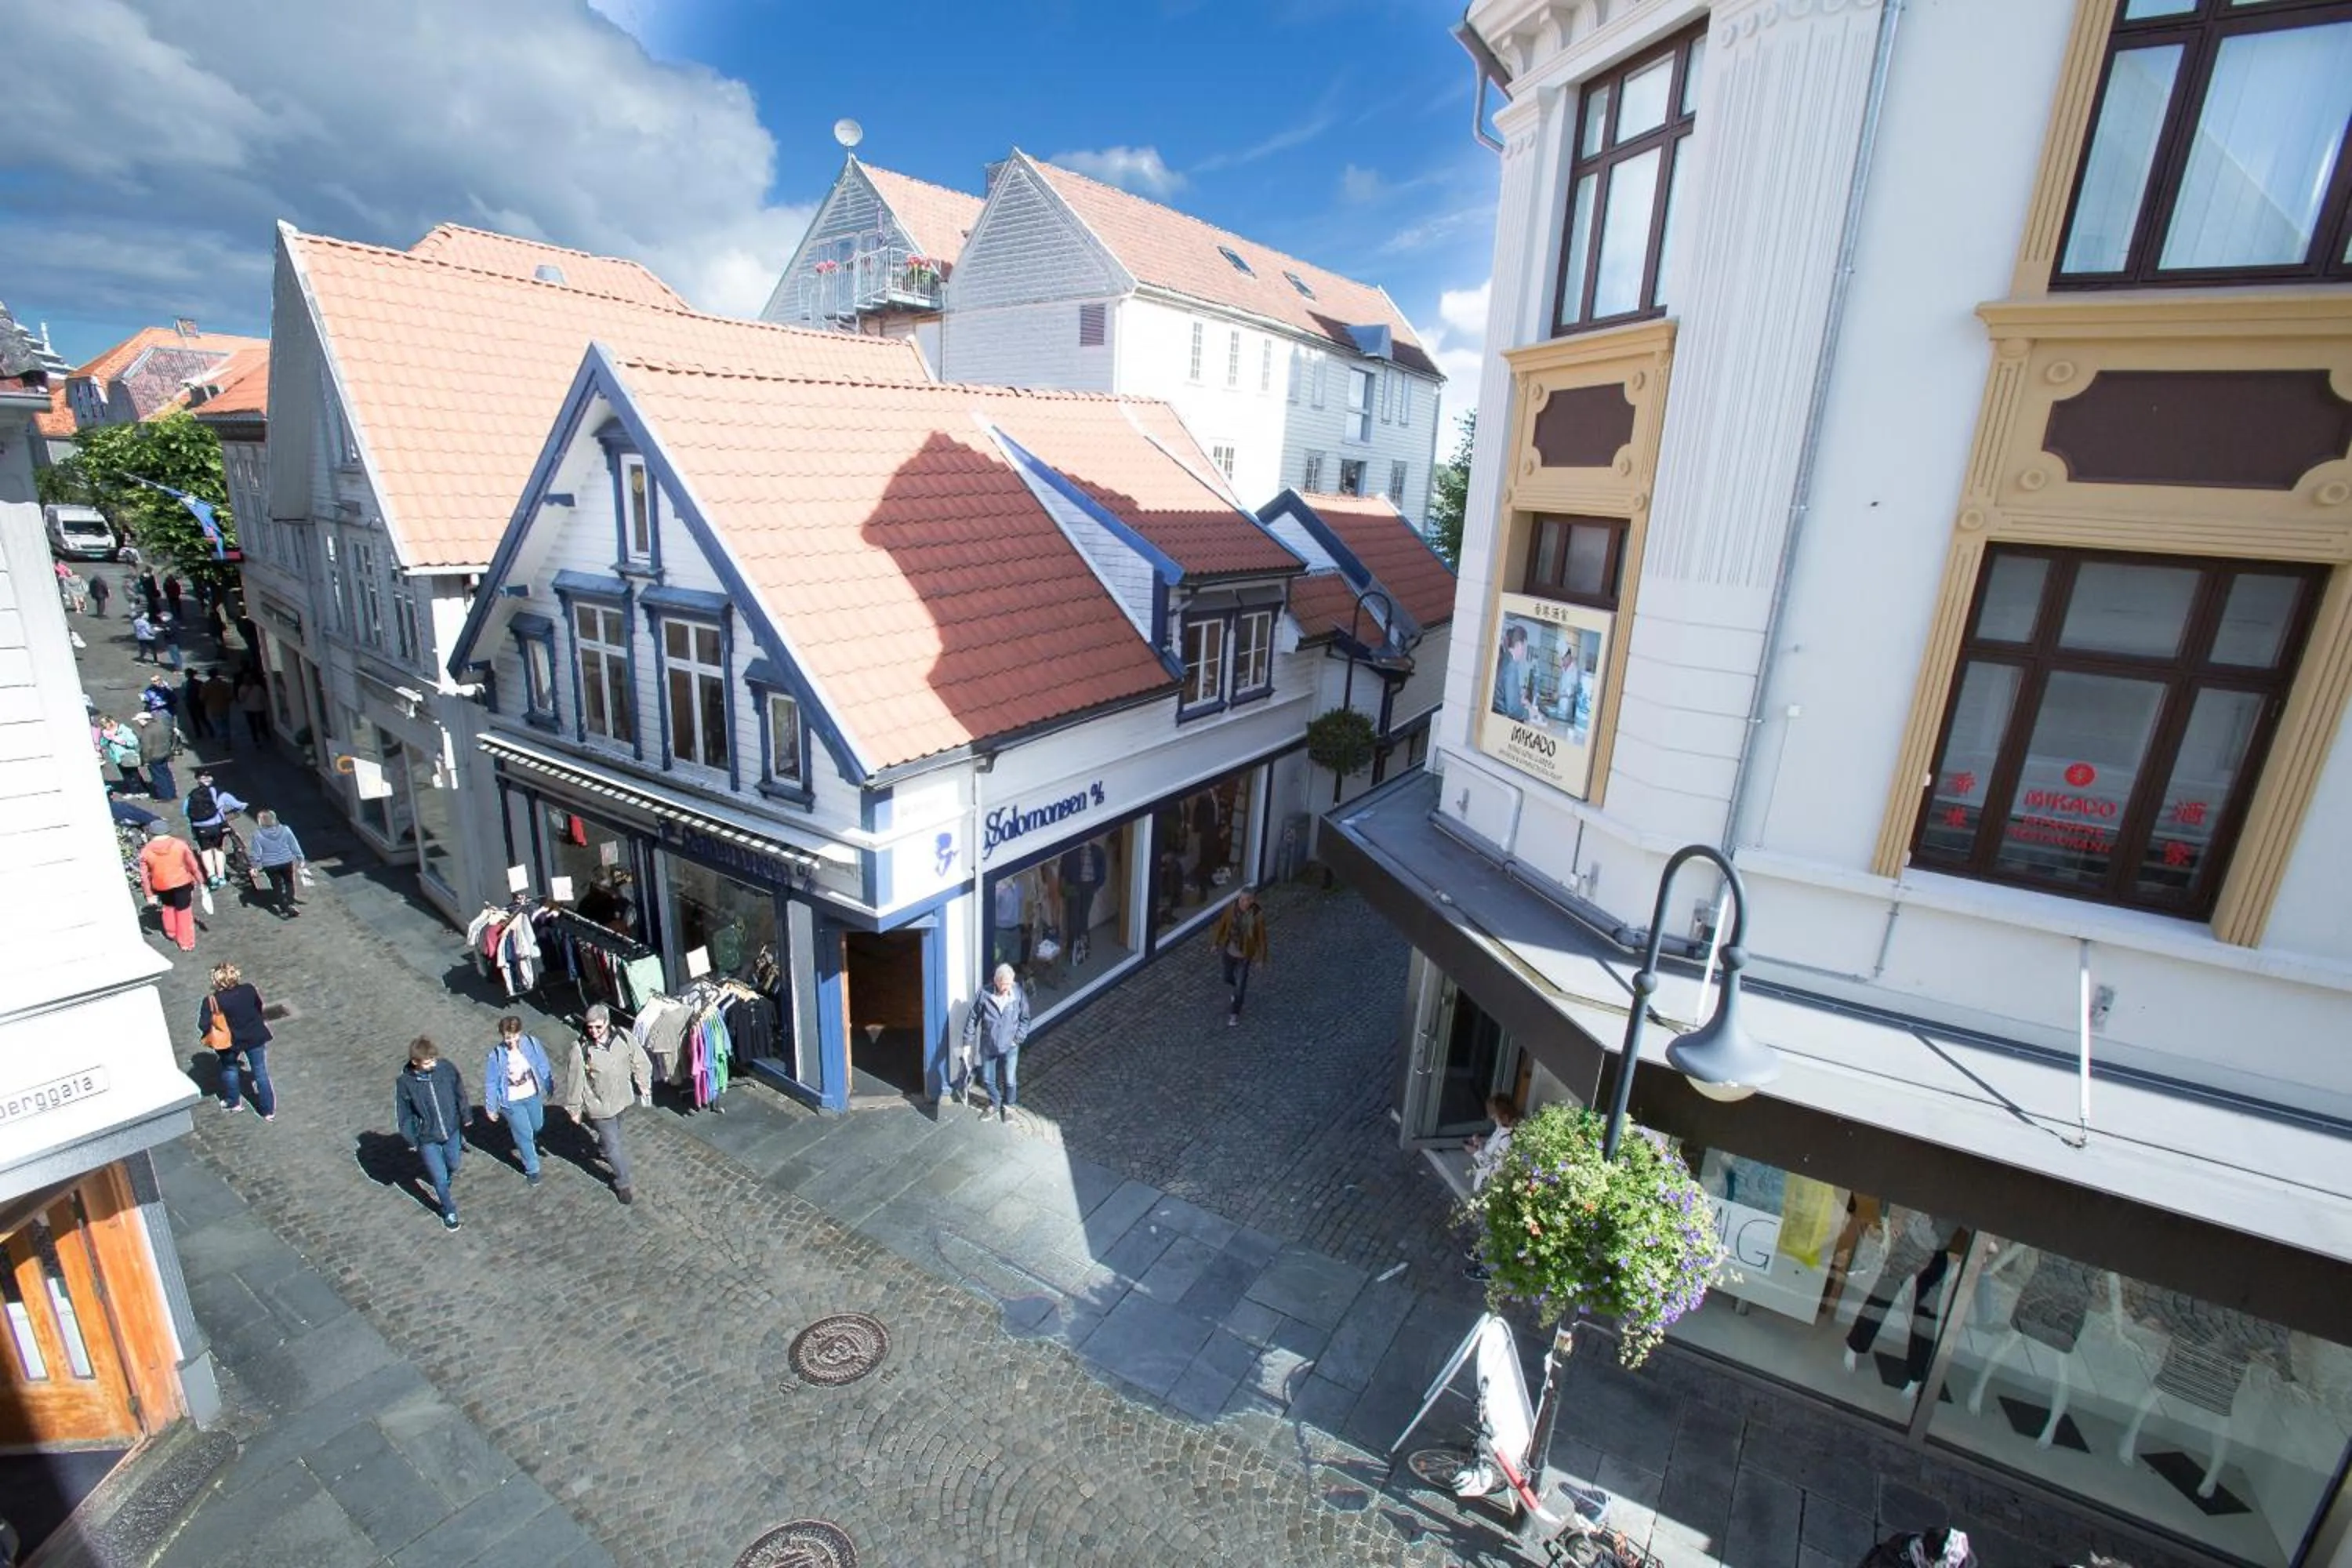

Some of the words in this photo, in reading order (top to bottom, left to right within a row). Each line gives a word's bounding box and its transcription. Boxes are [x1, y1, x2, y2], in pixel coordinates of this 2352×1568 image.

[1511, 724, 1556, 757] MIKADO
[2024, 789, 2117, 817] MIKADO
[982, 791, 1087, 860] Salomonsen
